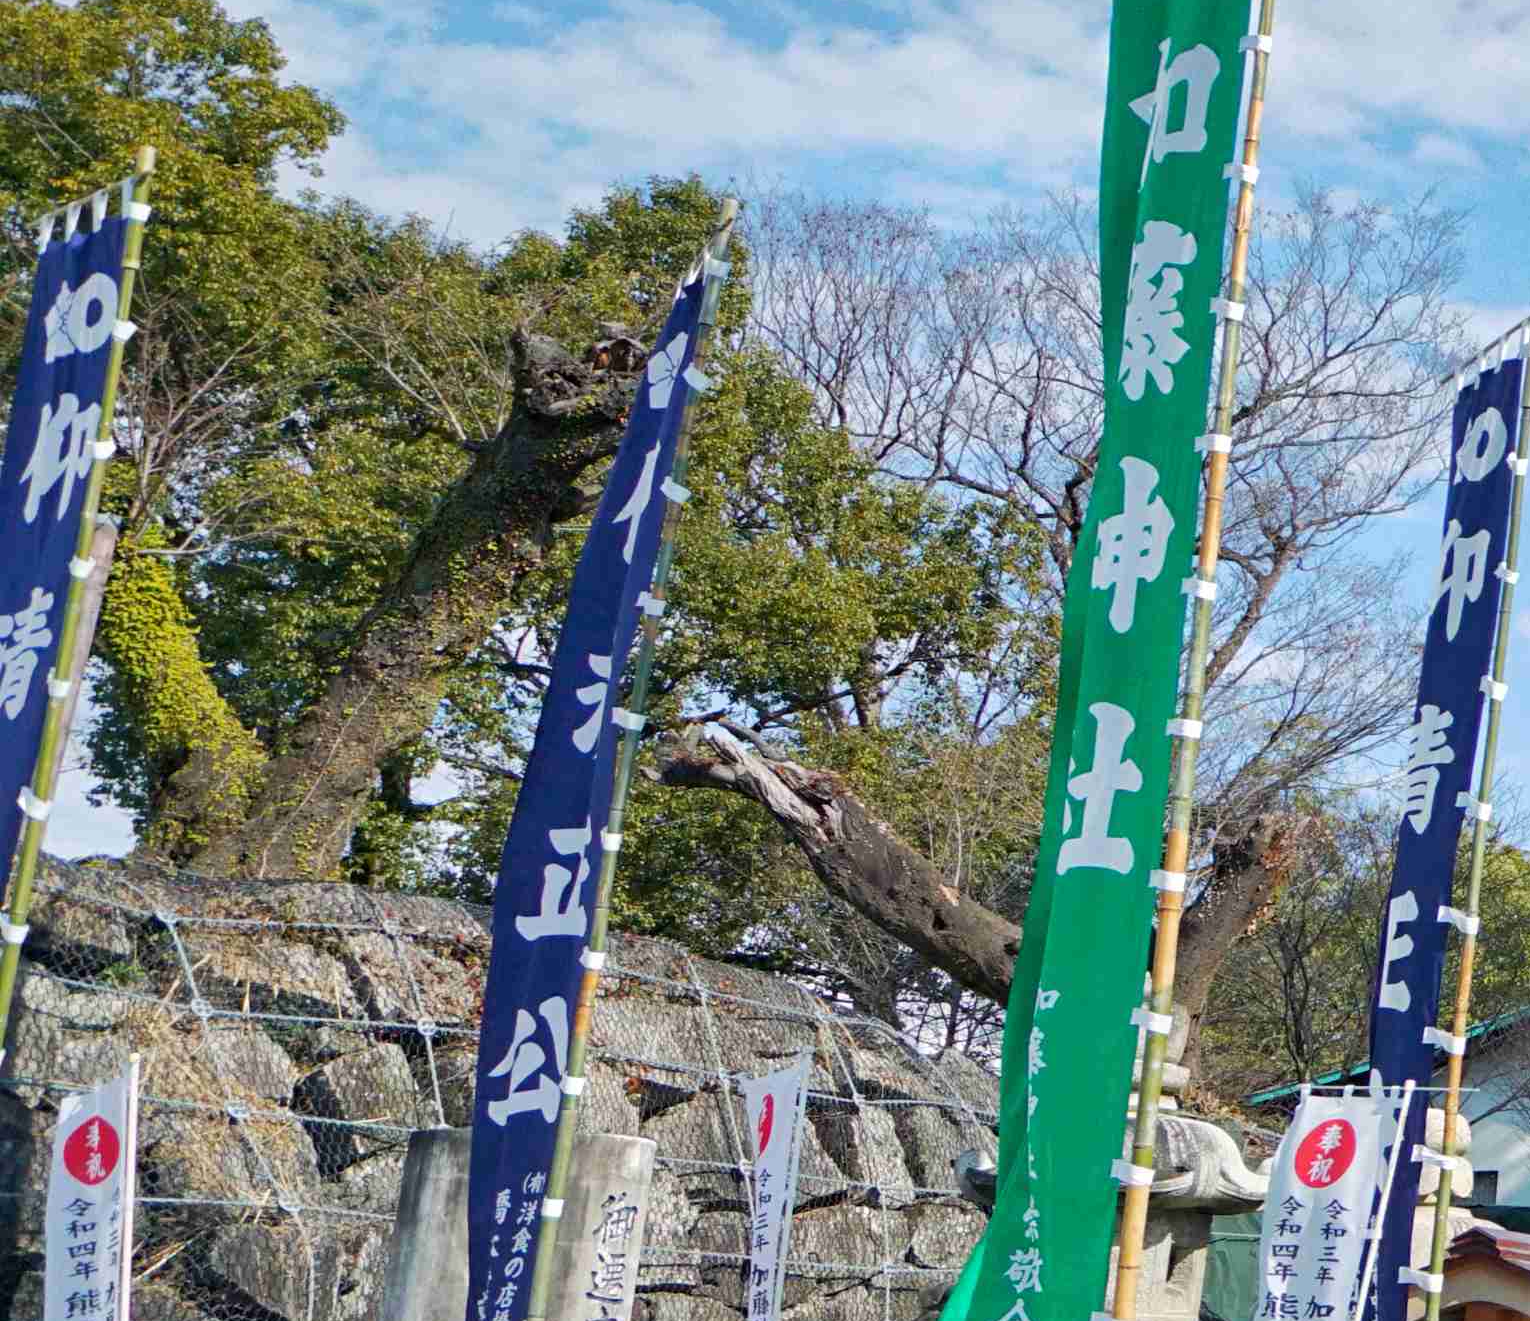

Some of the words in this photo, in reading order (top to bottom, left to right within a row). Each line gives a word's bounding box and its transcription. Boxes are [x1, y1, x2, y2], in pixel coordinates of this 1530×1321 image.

[1305, 1123, 1343, 1185] 奉祝
[63, 1196, 99, 1282] 令和四年
[1267, 1194, 1308, 1282] 令和四年
[1314, 1198, 1351, 1287] 令和三年
